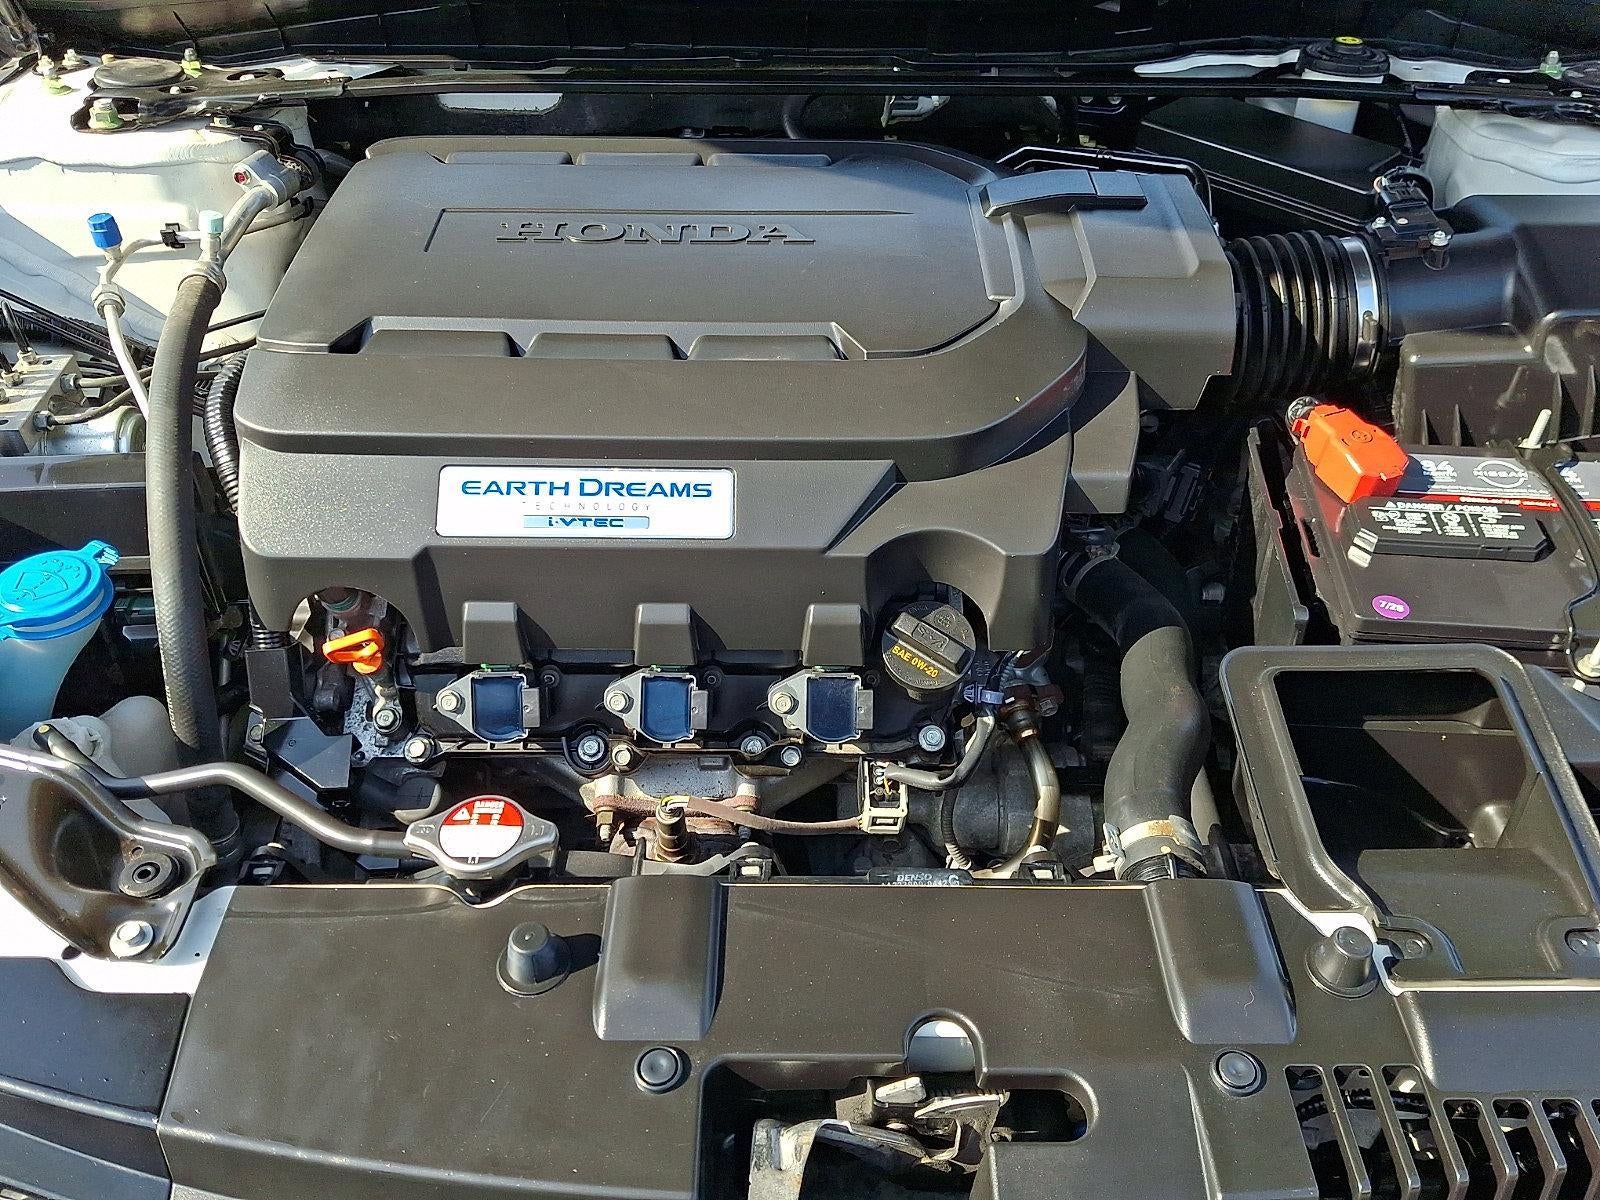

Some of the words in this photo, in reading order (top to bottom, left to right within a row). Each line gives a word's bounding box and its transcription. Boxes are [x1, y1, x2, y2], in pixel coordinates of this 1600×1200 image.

[496, 221, 816, 245] HONDA
[461, 479, 569, 496] EARTH
[579, 478, 712, 498] DREAMS
[522, 501, 650, 511] ECHNOLOGY
[1396, 501, 1445, 511] DANGER
[891, 645, 912, 662] SAE
[911, 656, 940, 678] 0W-20
[896, 872, 932, 882] DENSO
